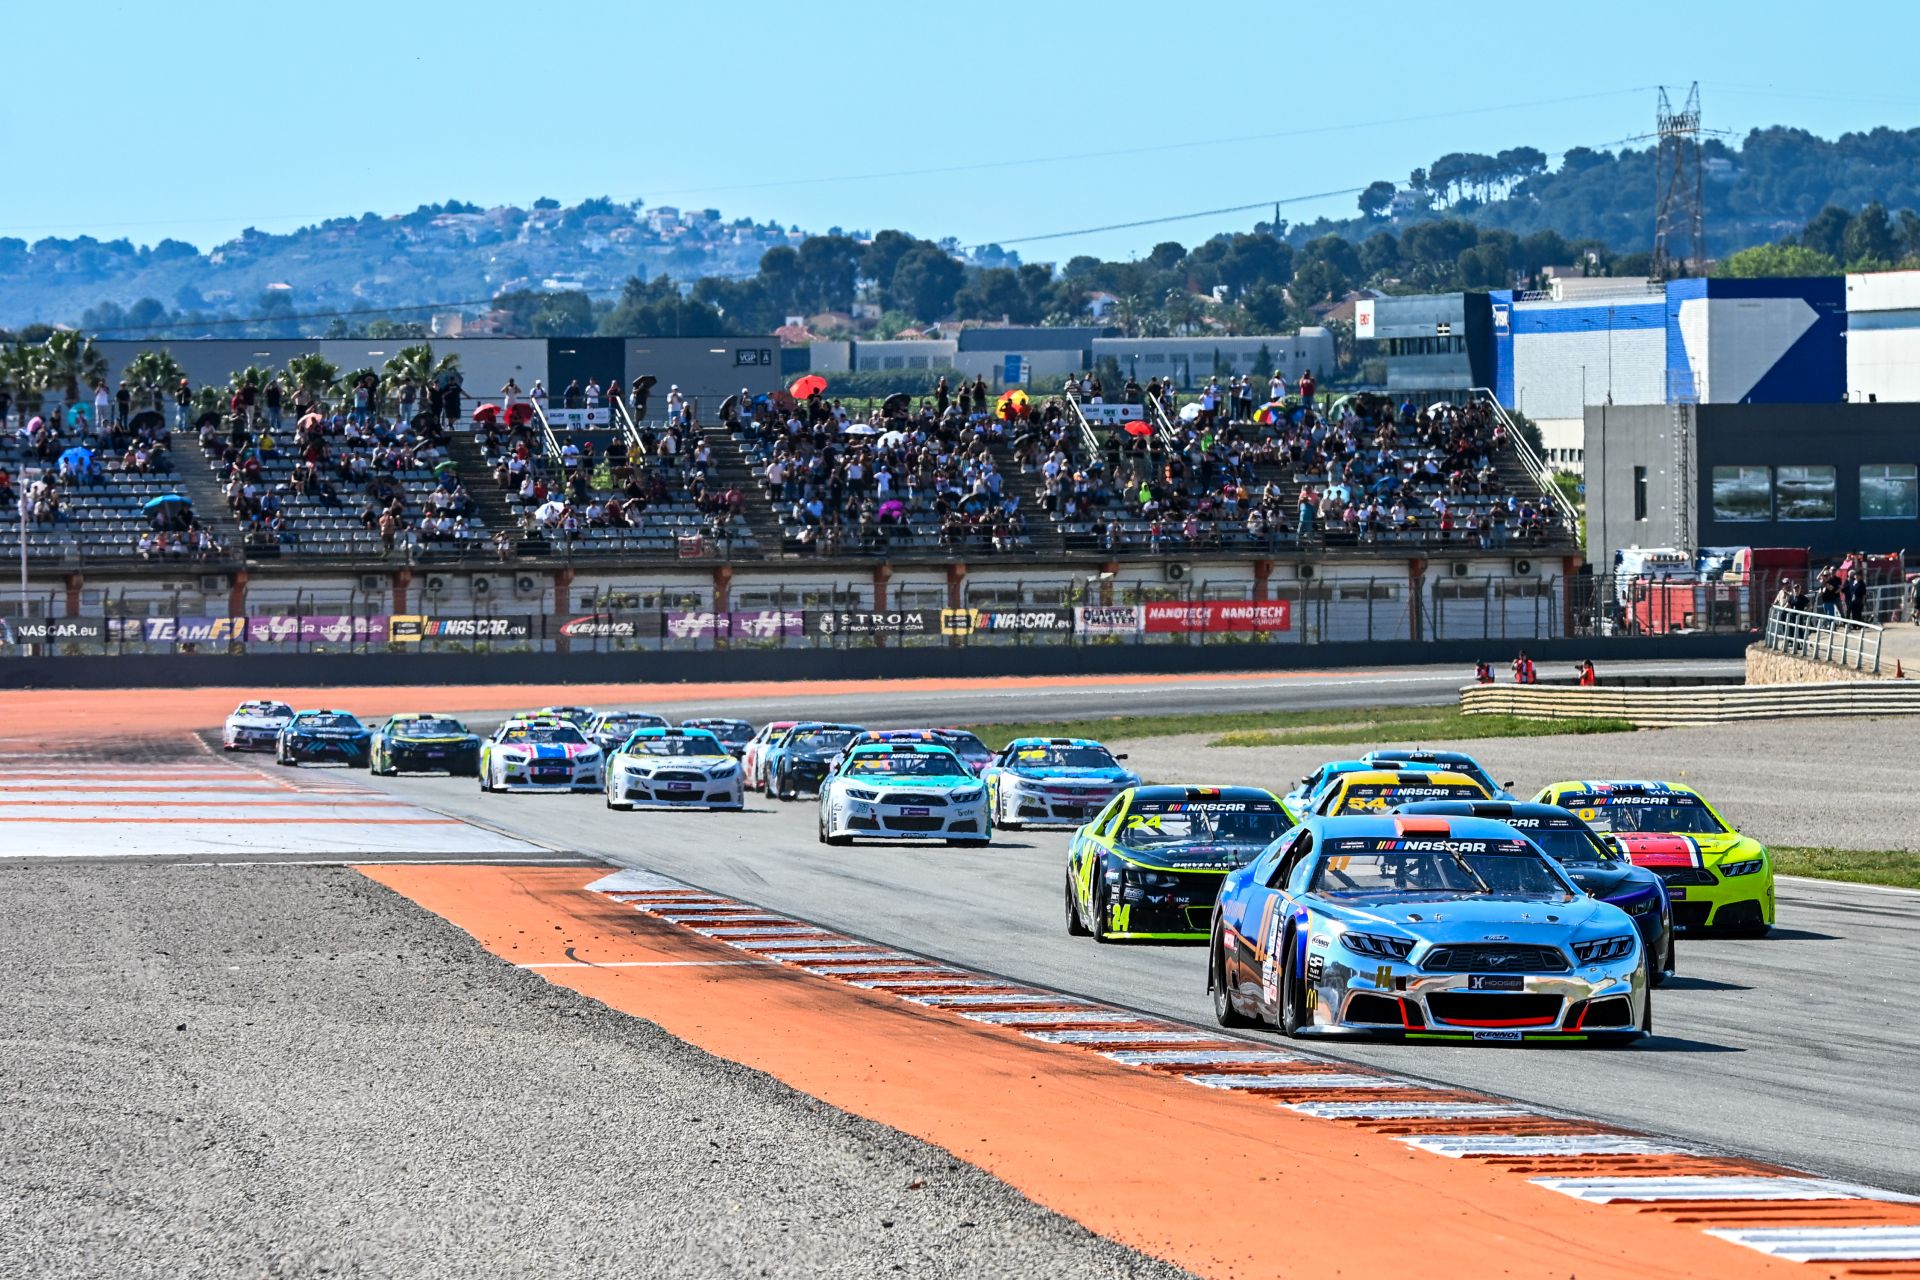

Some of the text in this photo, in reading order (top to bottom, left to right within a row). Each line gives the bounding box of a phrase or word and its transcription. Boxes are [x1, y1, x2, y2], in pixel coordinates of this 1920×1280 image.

[1149, 607, 1211, 619] NANOTECH
[1221, 606, 1284, 618] NANOTECH
[841, 613, 923, 625] STROM
[994, 612, 1072, 630] NASCAR.eu
[18, 623, 98, 637] NASCAR.eu
[444, 619, 526, 636] NASCAR.eu
[1397, 788, 1450, 796] NASCAR
[1347, 797, 1387, 809] 54
[1612, 797, 1669, 805] NASCAR
[1187, 803, 1246, 812] NASCAR
[1127, 814, 1162, 829] 24
[1403, 841, 1487, 853] NASCAR
[1112, 903, 1131, 932] 24
[1375, 965, 1393, 988] 11
[1475, 1031, 1520, 1039] KENNOL
